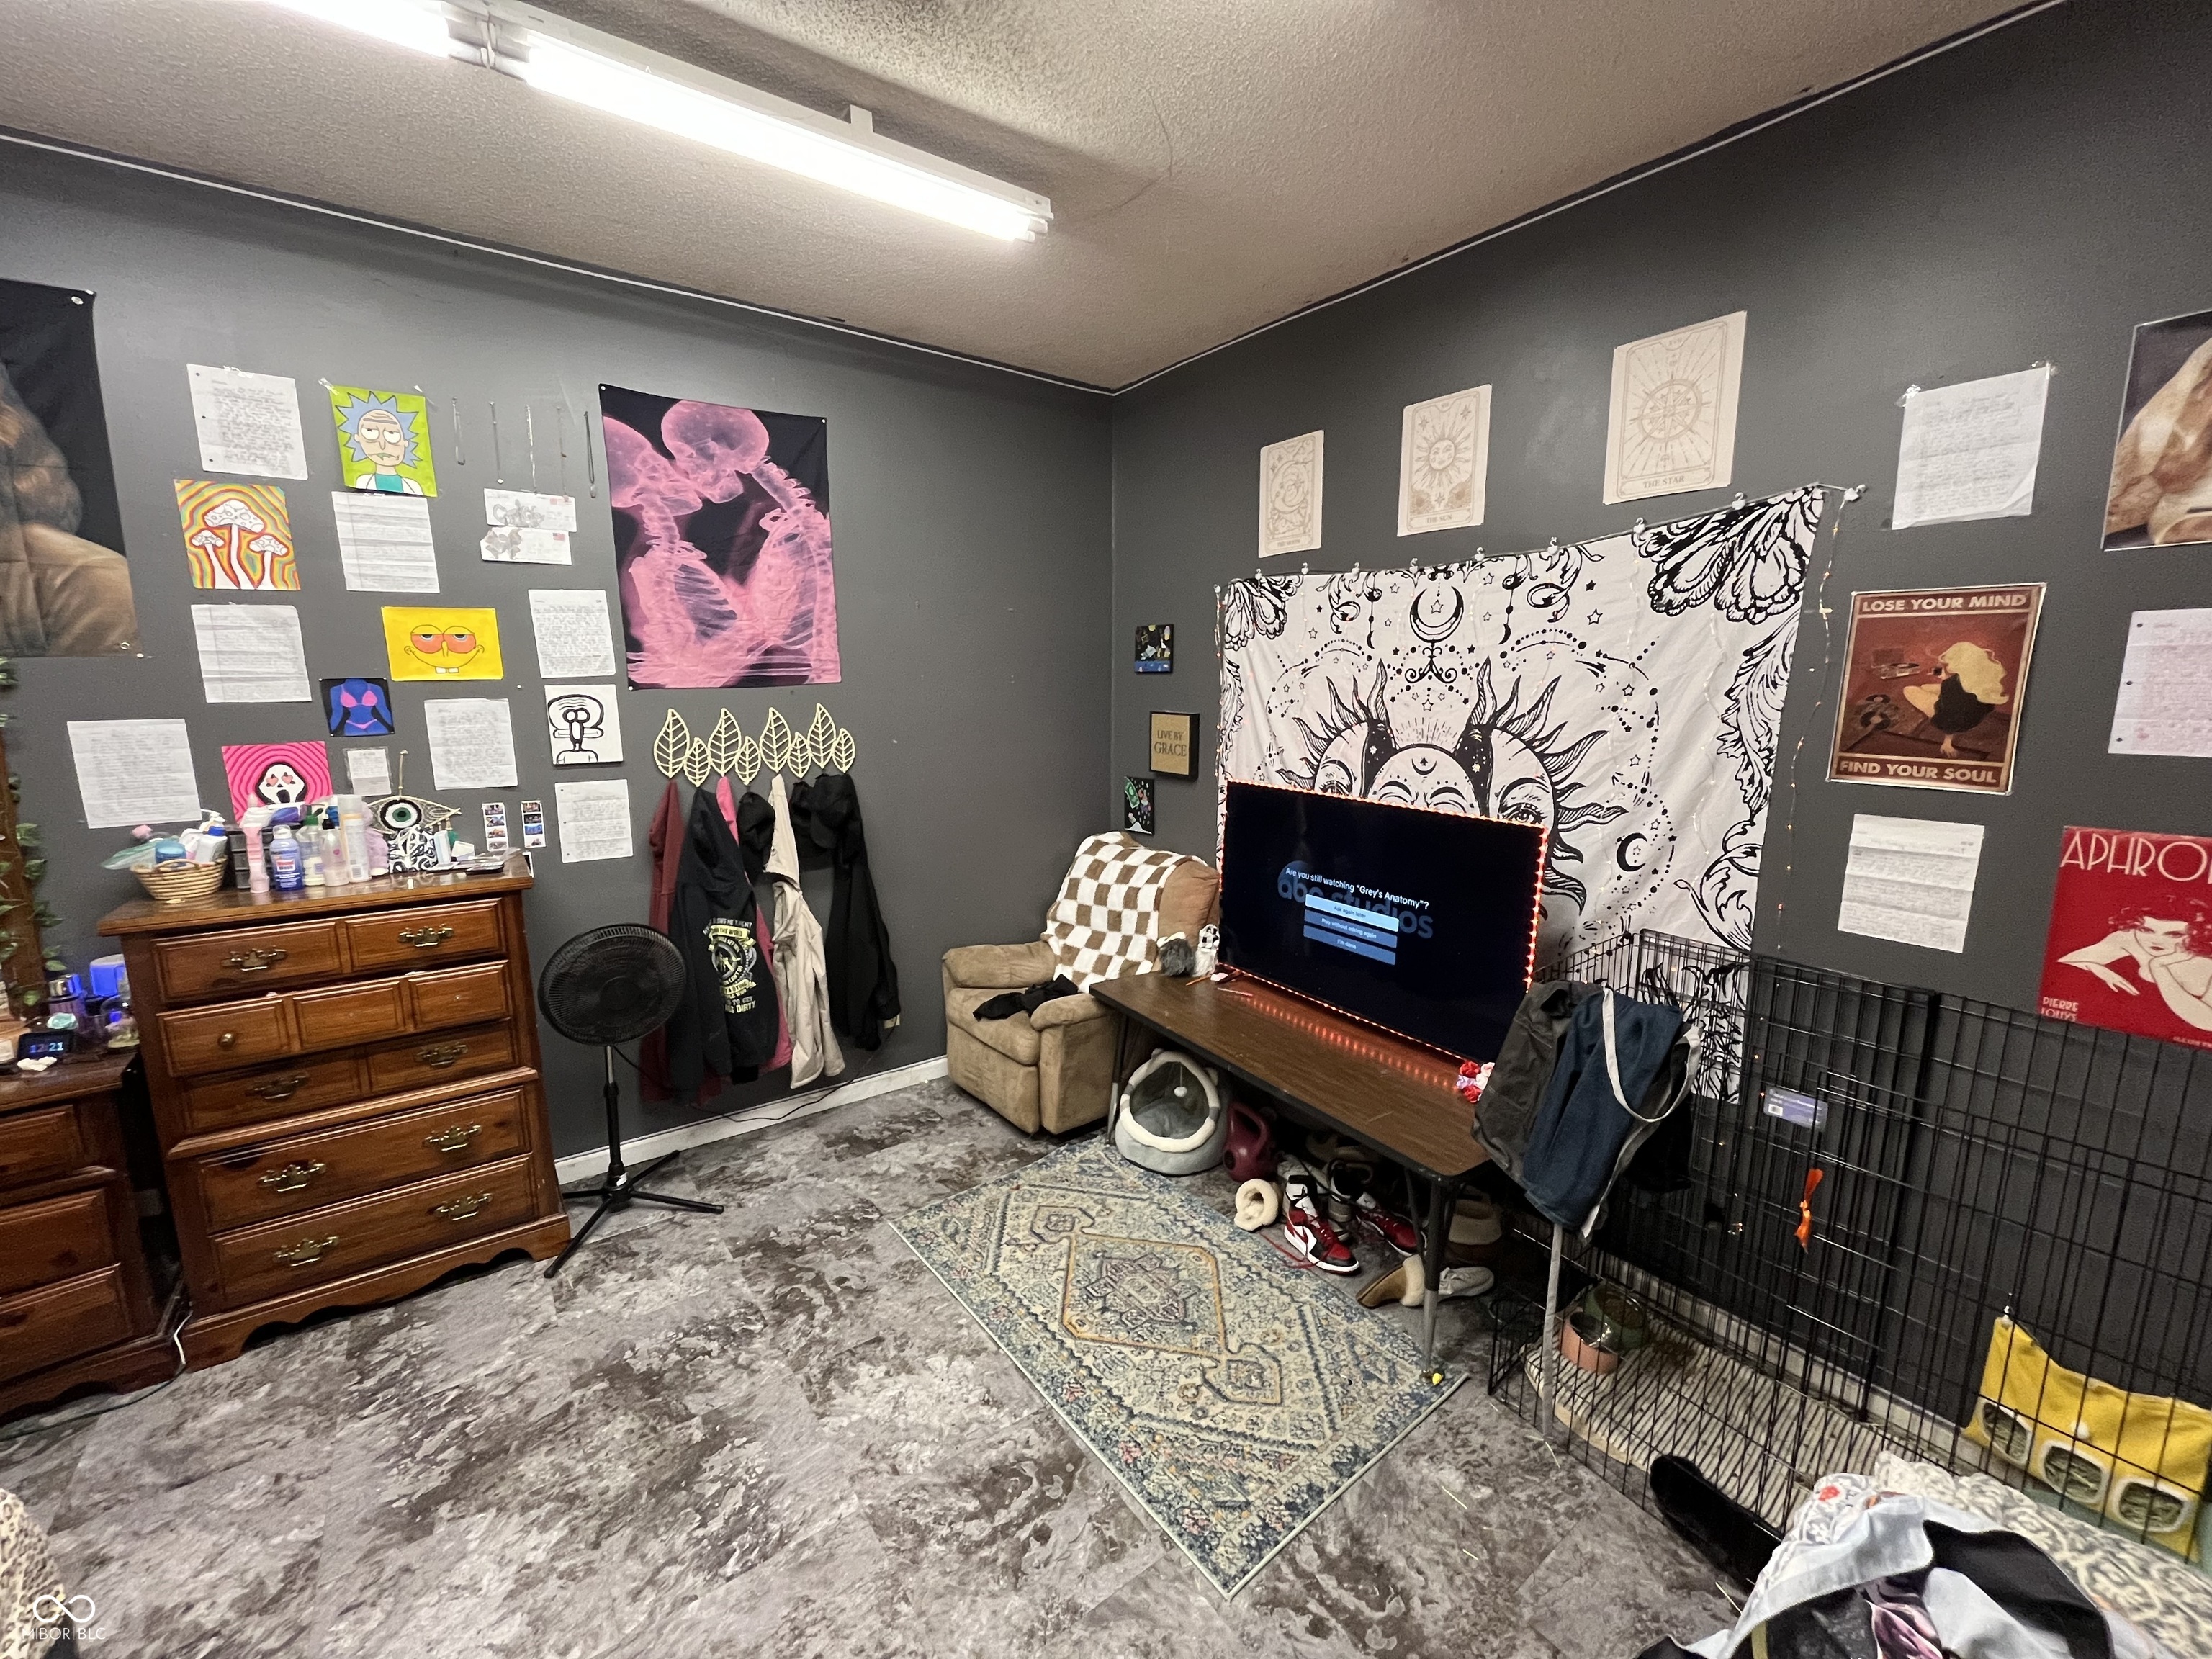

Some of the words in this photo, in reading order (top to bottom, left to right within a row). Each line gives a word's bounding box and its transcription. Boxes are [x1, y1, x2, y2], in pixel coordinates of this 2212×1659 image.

[1642, 480, 1660, 489] THE
[1663, 475, 1684, 485] STAR
[1862, 598, 1905, 612] LOSE
[1910, 597, 1963, 610] YOUR
[1968, 594, 2027, 608] MIND
[1157, 730, 1173, 740] LIVE
[1174, 731, 1183, 741] BY
[1154, 742, 1187, 757] GRACE
[1839, 761, 1881, 774] FIND
[1886, 763, 1938, 778] YOUR
[1943, 768, 1997, 783] SOUL
[2060, 831, 2212, 884] APHRO
[1286, 867, 1297, 877] Are
[1298, 871, 1310, 881] you
[1310, 873, 1323, 883] still
[1323, 877, 1355, 894] watching
[1356, 884, 1383, 899] "Grey's
[736, 999, 756, 1013] DIRTY
[2042, 996, 2079, 1012] PIERRE
